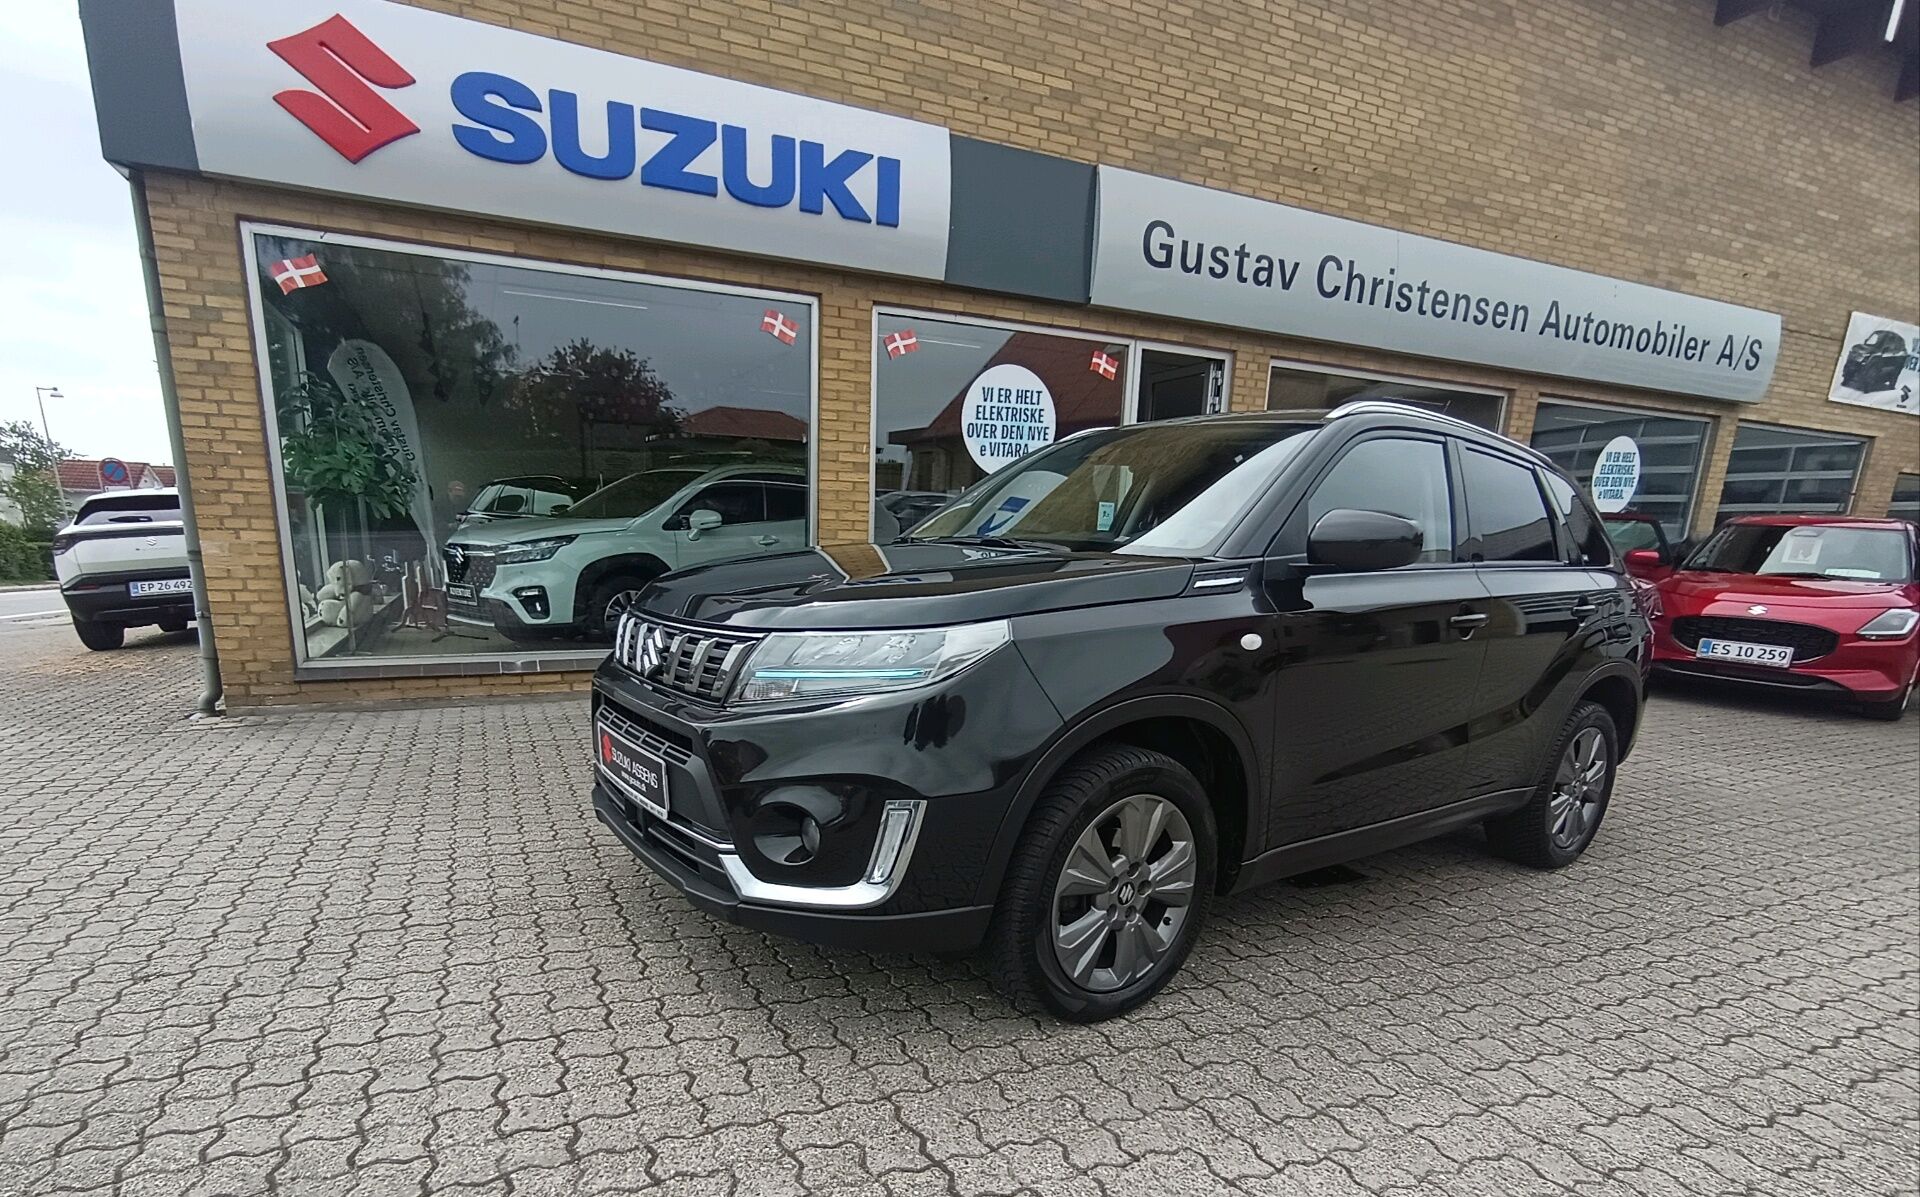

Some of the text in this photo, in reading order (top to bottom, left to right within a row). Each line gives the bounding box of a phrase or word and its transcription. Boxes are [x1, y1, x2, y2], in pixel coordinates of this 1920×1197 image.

[450, 71, 900, 228] SUZUKI
[1142, 219, 1764, 372] Gustav Christensen Automobiler A/S
[982, 386, 1043, 406] VI ER HELT
[975, 405, 1045, 424] ELEKTRISKE
[966, 422, 1050, 442] OVER DEN NYE
[989, 441, 1030, 458] VITARA
[1605, 451, 1636, 463] VI ER HELT
[1600, 464, 1636, 475] ELEKTRISKE
[1594, 476, 1610, 488] OVER
[1610, 476, 1623, 488] DEN
[140, 580, 193, 592] EP 26 492
[1710, 643, 1732, 655] ES
[1735, 645, 1754, 658] 10
[1757, 648, 1788, 662] 259
